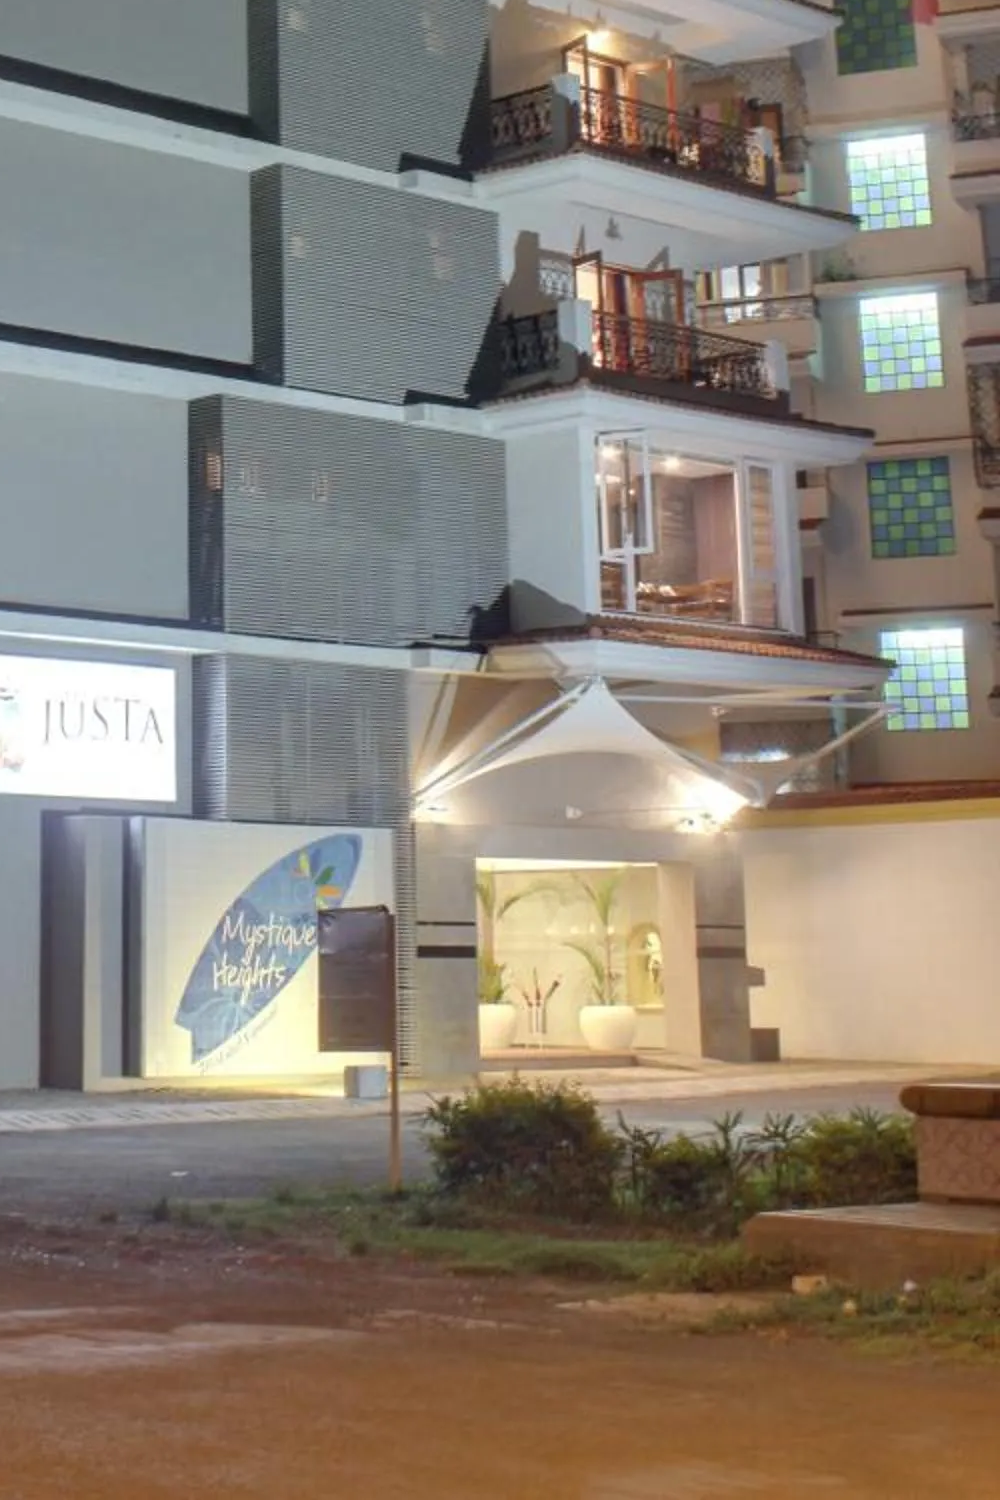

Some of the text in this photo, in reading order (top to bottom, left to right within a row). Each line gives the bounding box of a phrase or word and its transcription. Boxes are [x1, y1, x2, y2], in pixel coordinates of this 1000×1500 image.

[42, 697, 164, 744] JUSTA
[222, 911, 317, 964] Mystique
[213, 953, 286, 1006] Heights
